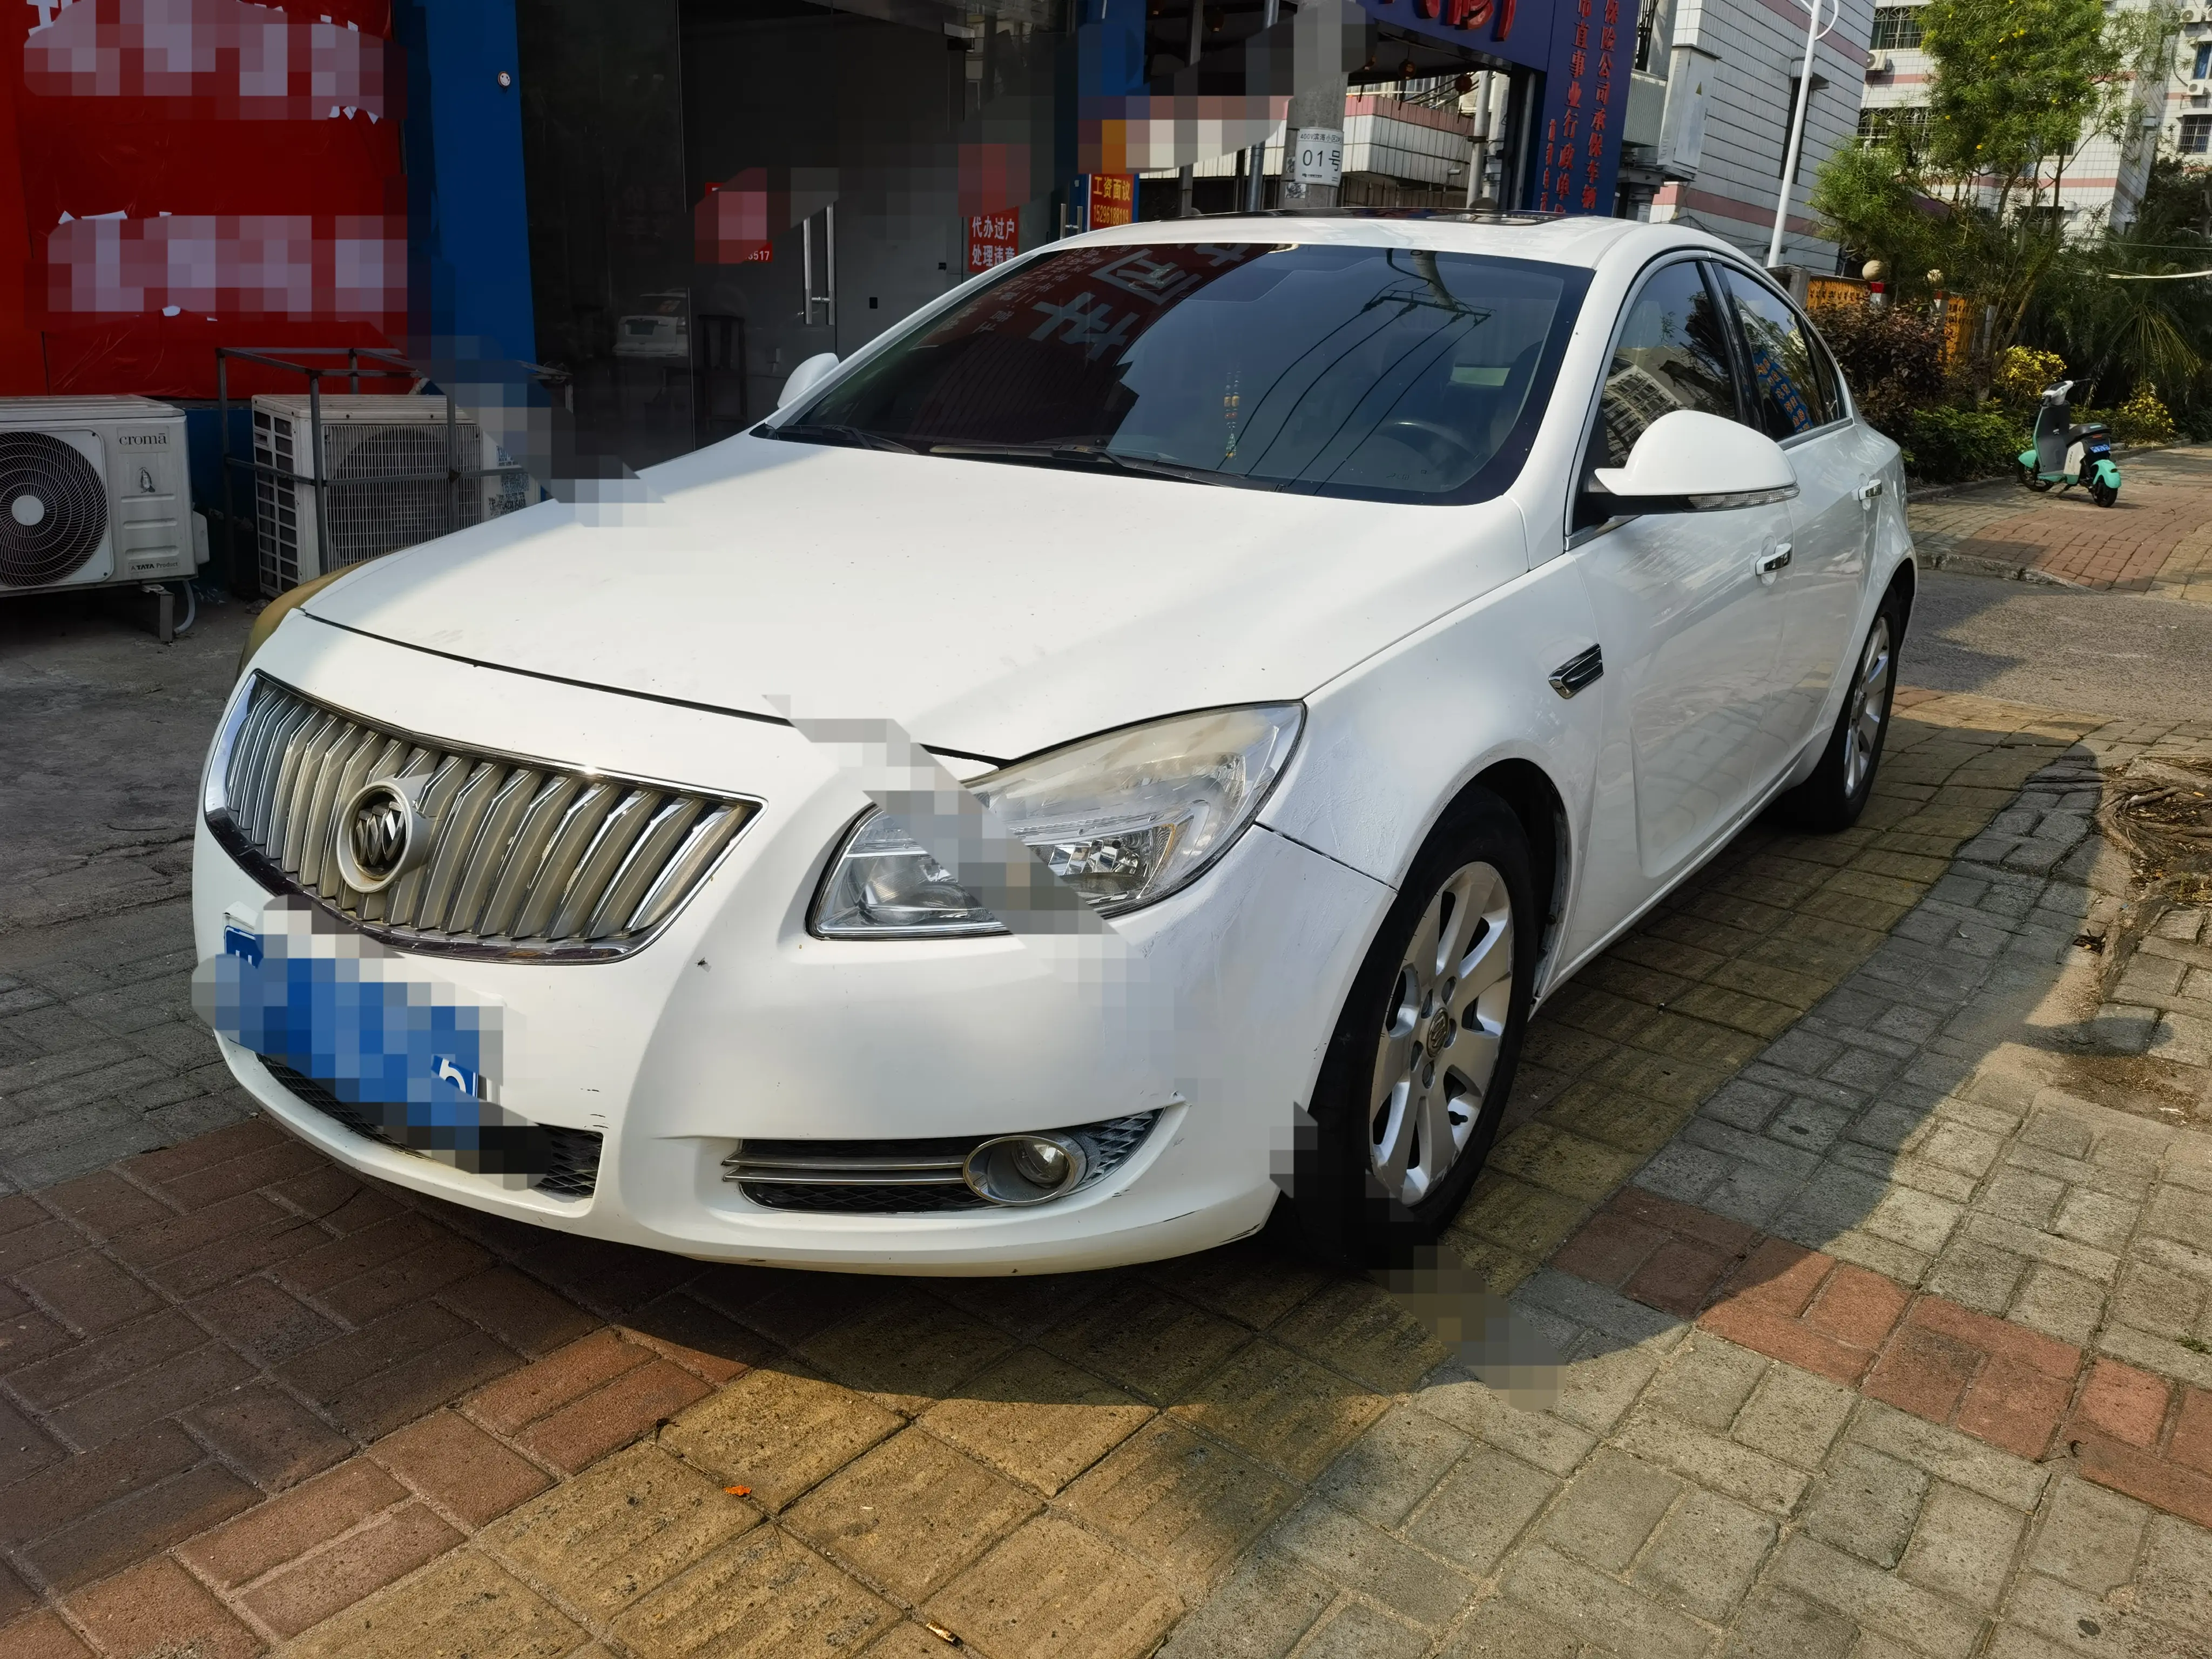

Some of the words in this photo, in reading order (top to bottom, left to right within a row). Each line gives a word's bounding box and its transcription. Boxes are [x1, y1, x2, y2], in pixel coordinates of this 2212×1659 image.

[1303, 150, 1340, 172] 01号
[1093, 177, 1130, 201] 工资面议
[1094, 204, 1129, 225] 15296188119
[972, 215, 1015, 240] 代办过户
[972, 244, 1015, 267] 处理违章
